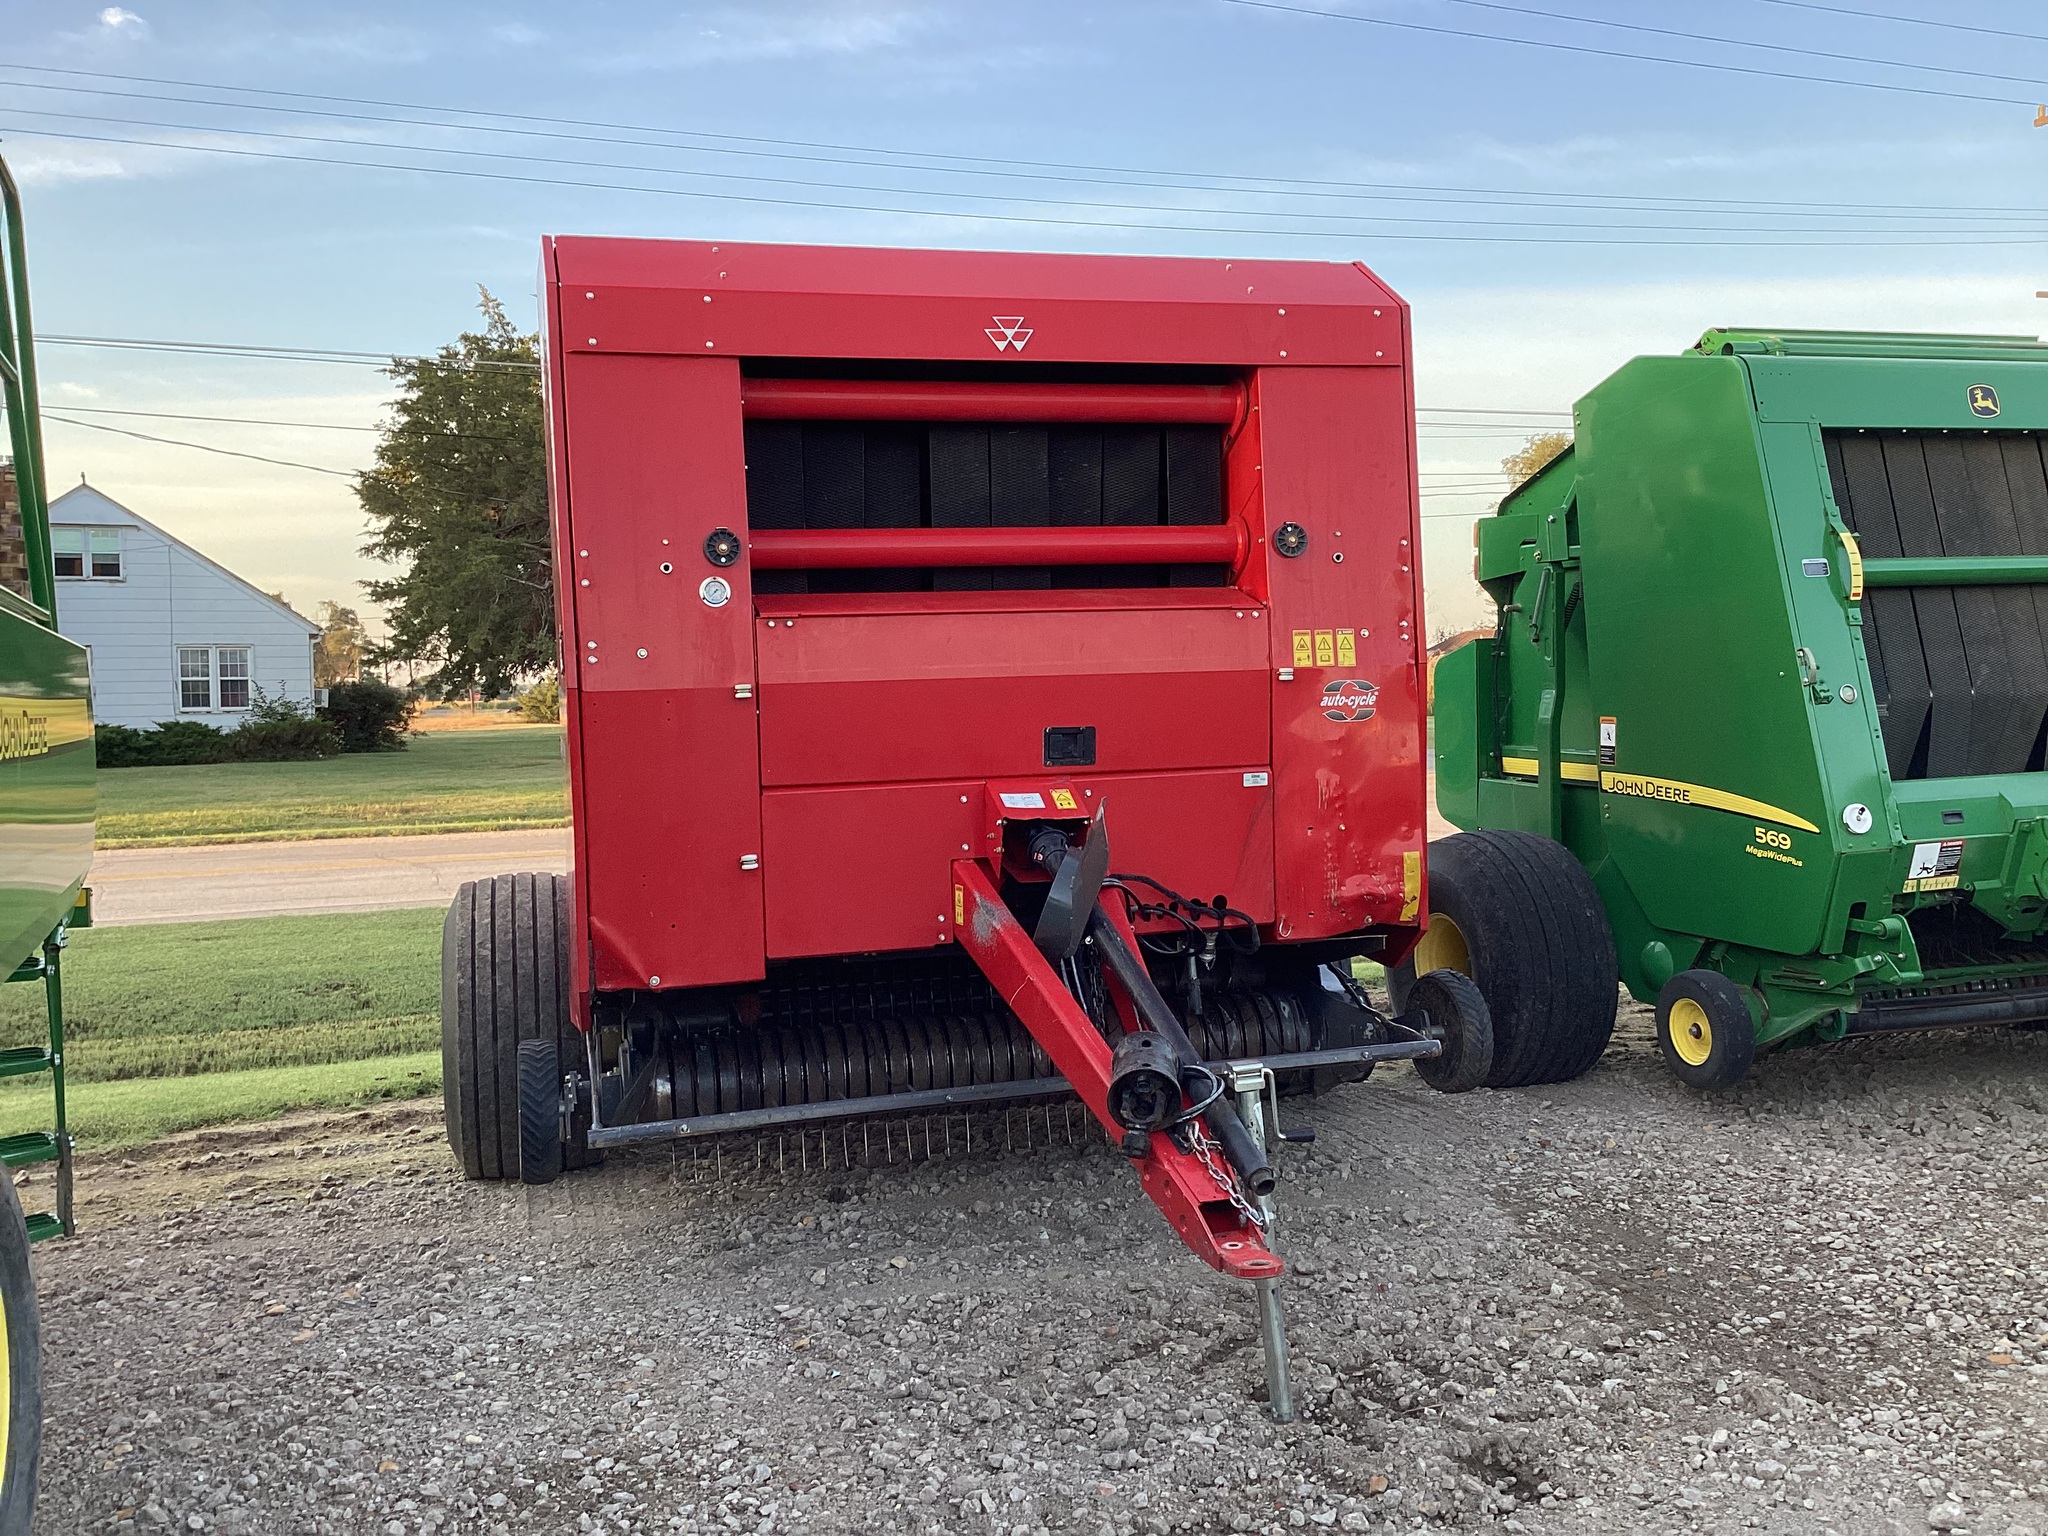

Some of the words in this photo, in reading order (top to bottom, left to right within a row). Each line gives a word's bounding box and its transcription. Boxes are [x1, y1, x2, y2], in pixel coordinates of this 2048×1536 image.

[1320, 692, 1376, 709] auto-cycle
[22, 709, 48, 751] DEERE
[1608, 777, 1643, 795] JOHN
[1645, 781, 1690, 802] DEERE
[1754, 826, 1792, 850] 569
[1745, 844, 1803, 867] MegaWidePlus
